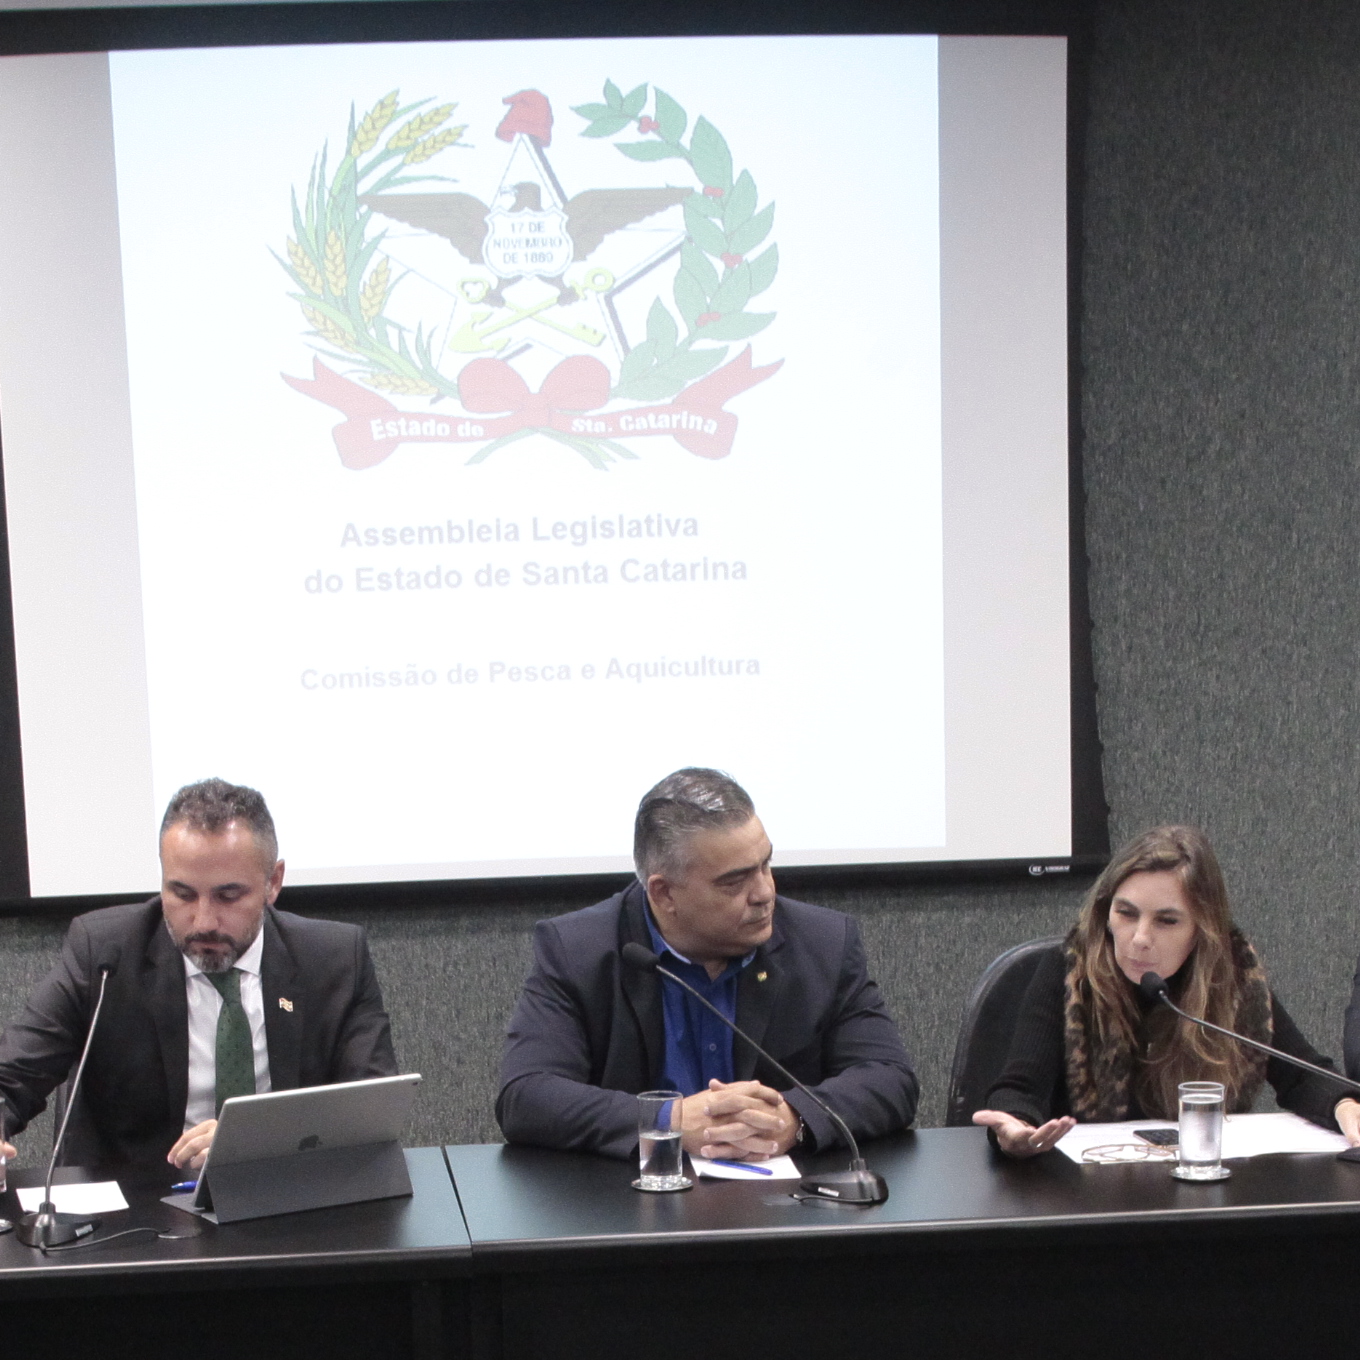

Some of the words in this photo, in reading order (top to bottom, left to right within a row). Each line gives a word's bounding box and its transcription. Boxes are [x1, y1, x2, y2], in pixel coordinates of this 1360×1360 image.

[528, 221, 545, 233] DE
[503, 252, 519, 265] DE
[370, 417, 451, 441] Estado
[457, 421, 484, 437] de
[571, 418, 613, 433] Sta.
[619, 410, 718, 435] Catarina
[340, 516, 520, 548] Assembleia
[532, 512, 699, 548] Legislativa
[303, 568, 344, 595] do
[354, 564, 463, 593] Estado
[473, 561, 512, 589] de
[521, 560, 609, 588] Santa
[619, 555, 748, 584] Catarina
[300, 662, 438, 691] Comissão
[446, 662, 480, 686] de
[488, 659, 572, 684] Pesca
[581, 664, 596, 681] e
[605, 653, 762, 685] Aquicultura
